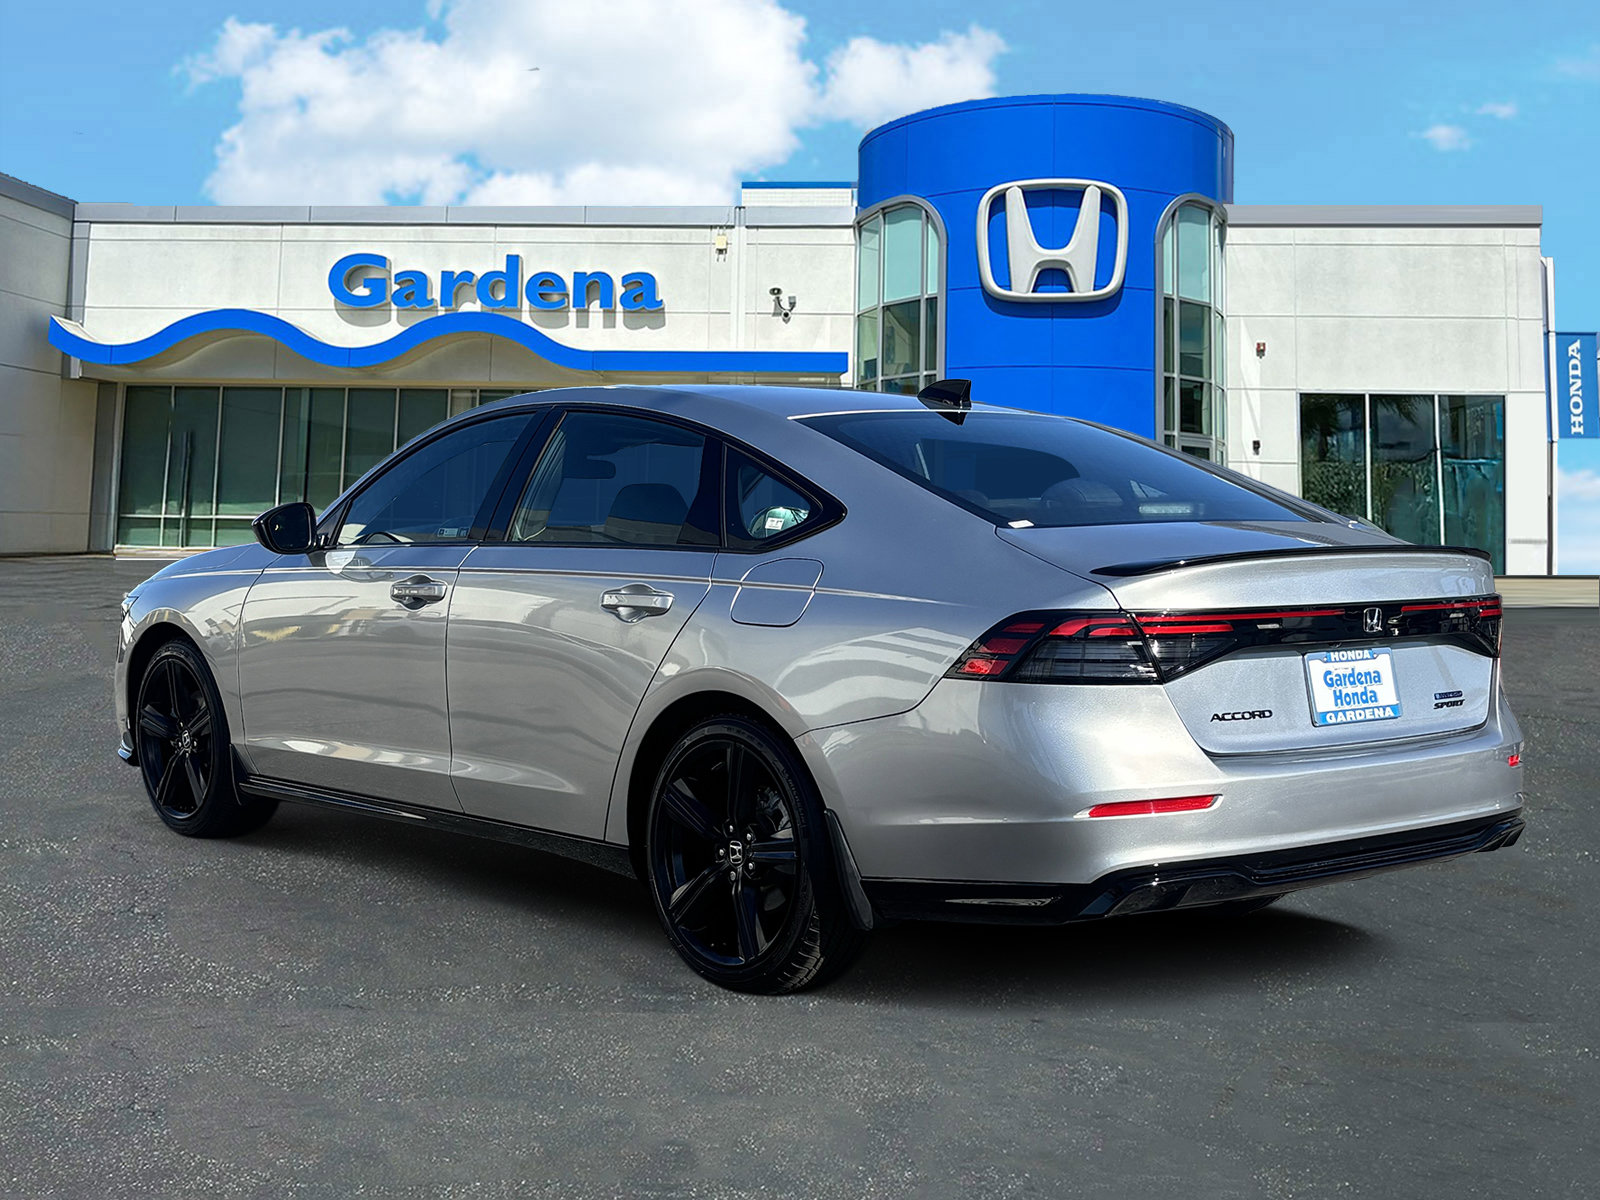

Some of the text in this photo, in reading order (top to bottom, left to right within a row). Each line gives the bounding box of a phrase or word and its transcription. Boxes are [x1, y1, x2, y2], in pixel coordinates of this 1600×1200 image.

[328, 253, 664, 310] Gardena
[1567, 339, 1584, 435] HONDA
[1330, 649, 1372, 662] HONDA
[1323, 667, 1383, 688] Gardena
[1333, 686, 1379, 707] Honda
[1210, 709, 1273, 722] ACCORD
[1326, 706, 1395, 723] GARDENA
